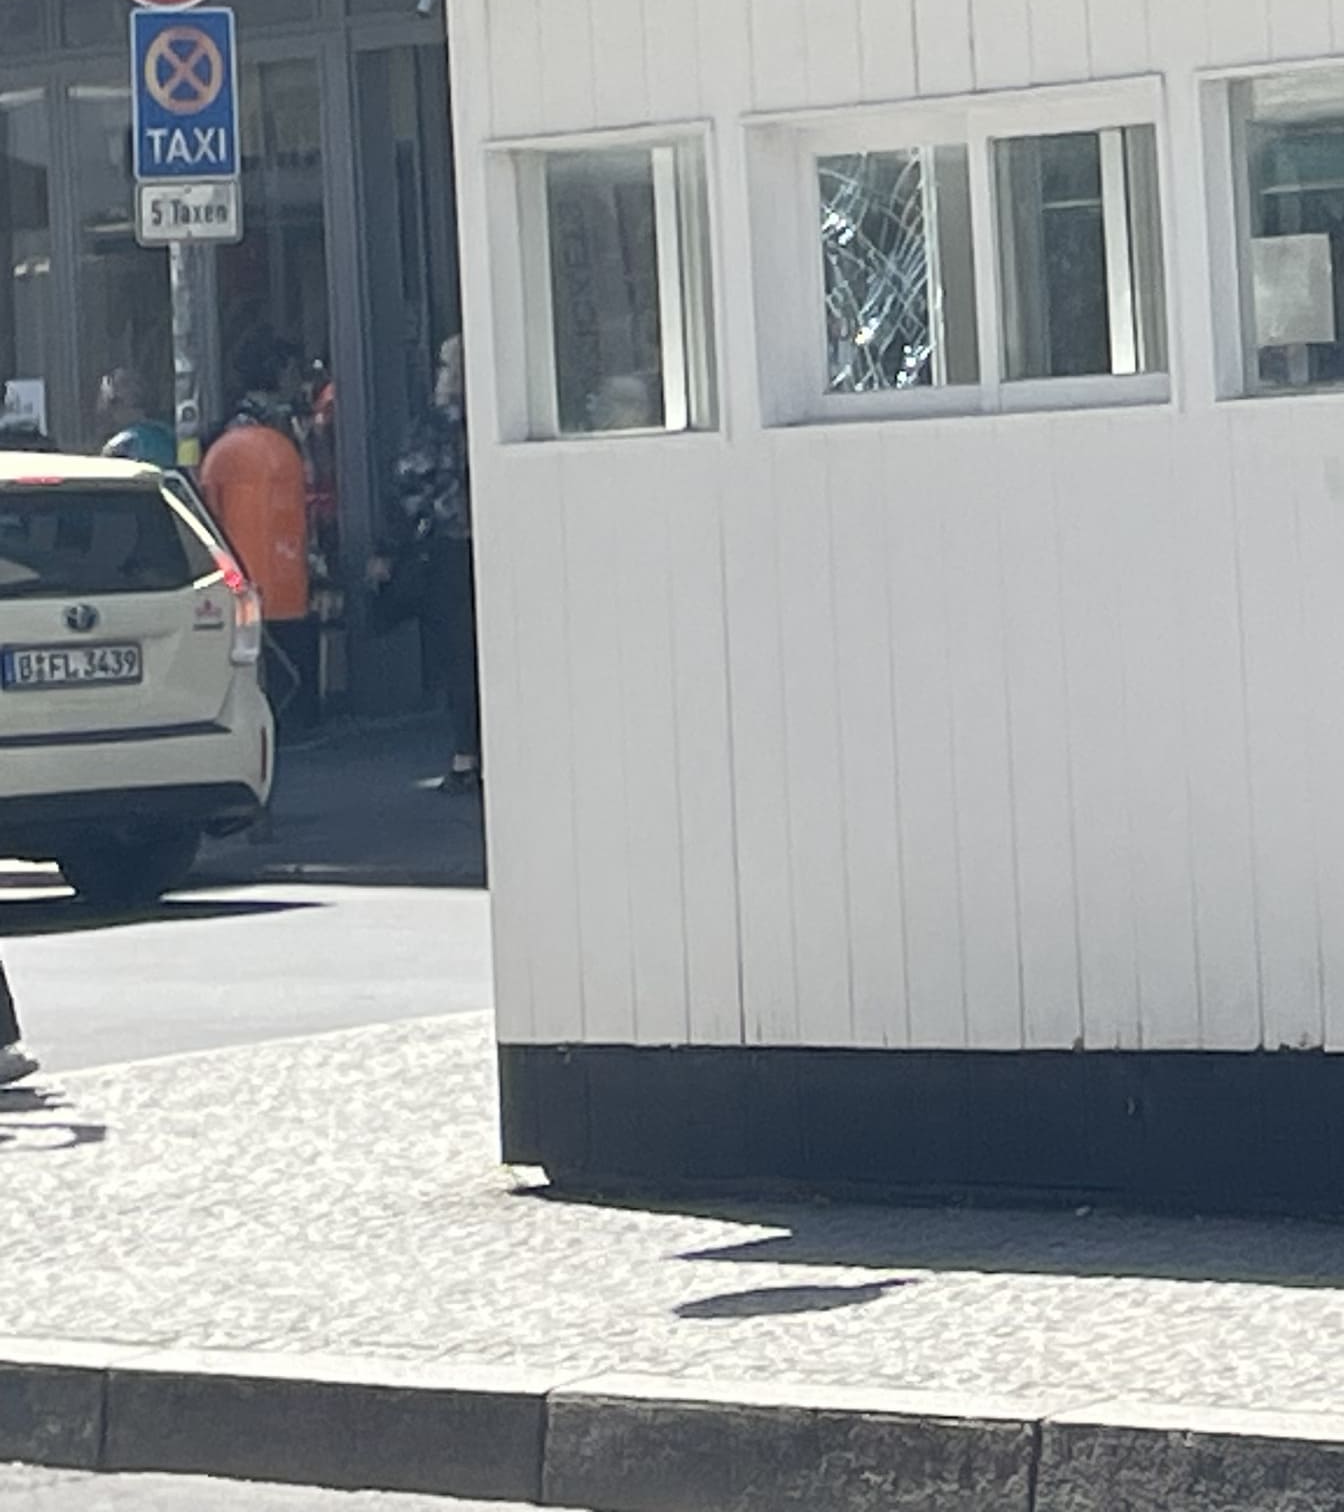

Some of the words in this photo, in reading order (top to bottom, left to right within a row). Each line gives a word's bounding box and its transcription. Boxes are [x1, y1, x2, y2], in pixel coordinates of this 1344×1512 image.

[145, 126, 228, 165] TAXI
[151, 200, 163, 226] 5
[172, 199, 229, 226] Taxen
